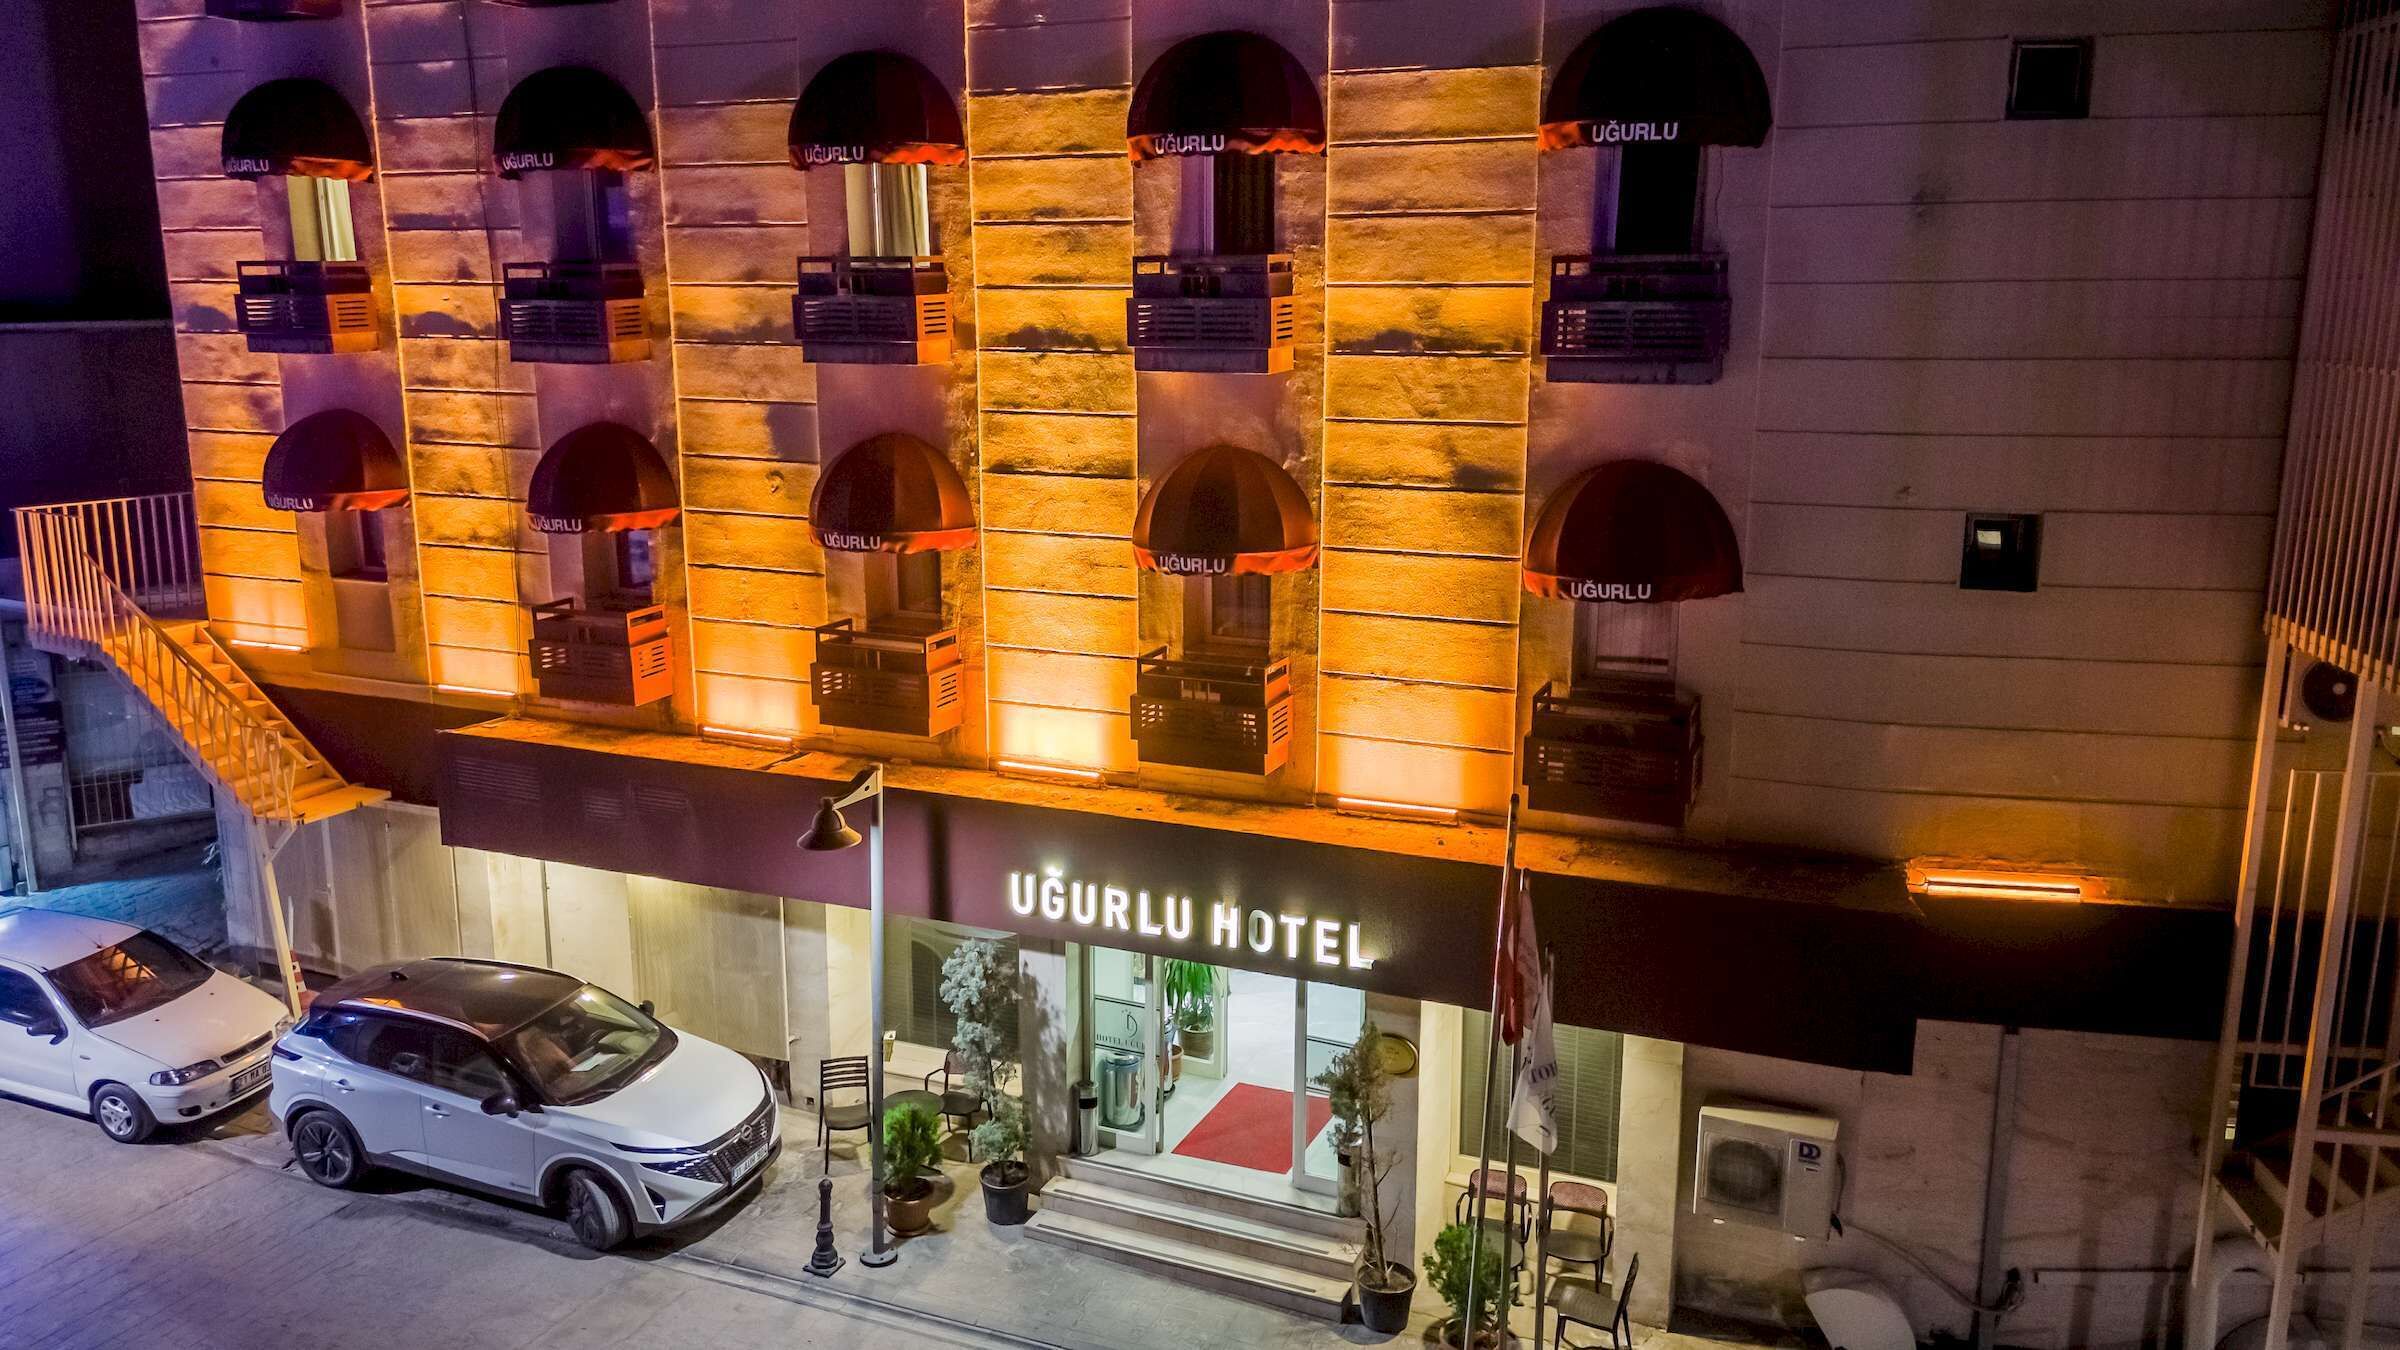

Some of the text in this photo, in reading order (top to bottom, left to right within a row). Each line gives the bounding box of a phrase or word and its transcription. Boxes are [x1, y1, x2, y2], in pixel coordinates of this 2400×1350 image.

[1592, 120, 1679, 143] UĞURLU
[805, 144, 864, 164] UĞURLU
[1155, 133, 1225, 155] UĞURLU
[502, 152, 554, 171] UĞURLU
[533, 516, 582, 533] UĞURLU
[824, 532, 881, 551] UĞURLU
[1159, 554, 1226, 574] UĞURLU
[1570, 579, 1652, 601] UĞURLU
[1009, 866, 1374, 969] UĞURLU HOTEL
